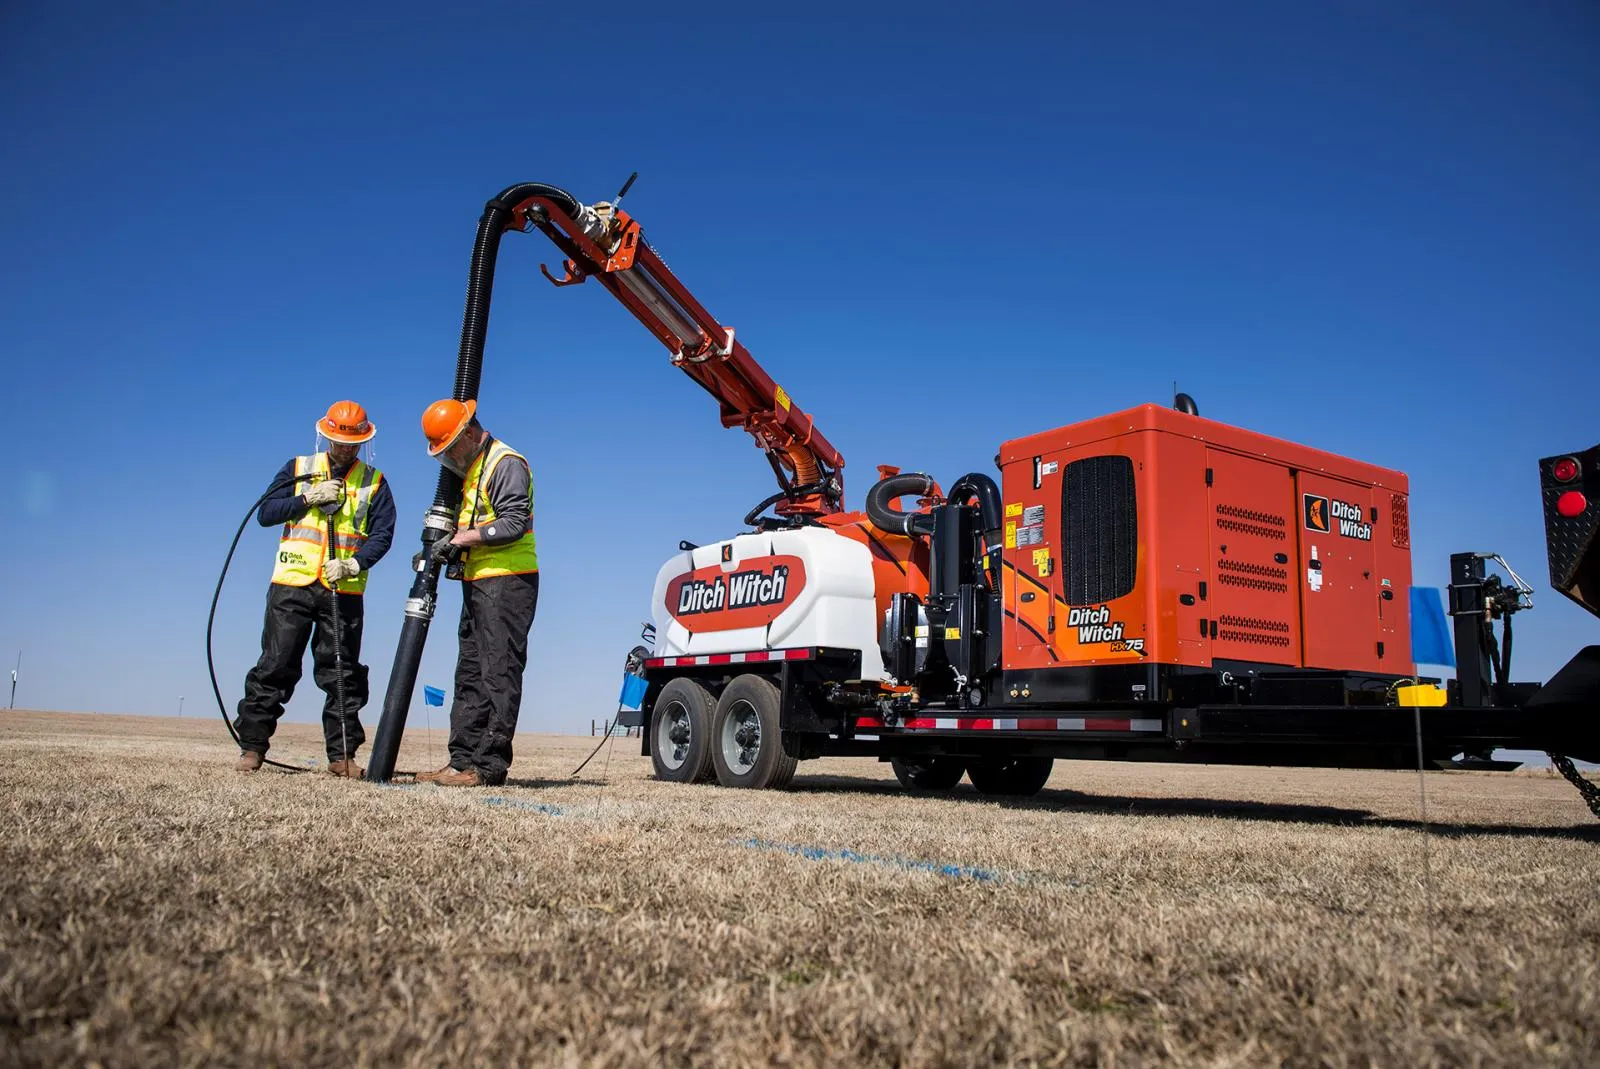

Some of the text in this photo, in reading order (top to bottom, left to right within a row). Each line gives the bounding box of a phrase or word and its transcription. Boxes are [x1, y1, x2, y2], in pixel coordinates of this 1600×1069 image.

[1331, 500, 1361, 521] Ditch
[679, 580, 725, 613] Ditch
[1068, 606, 1109, 626] Ditch
